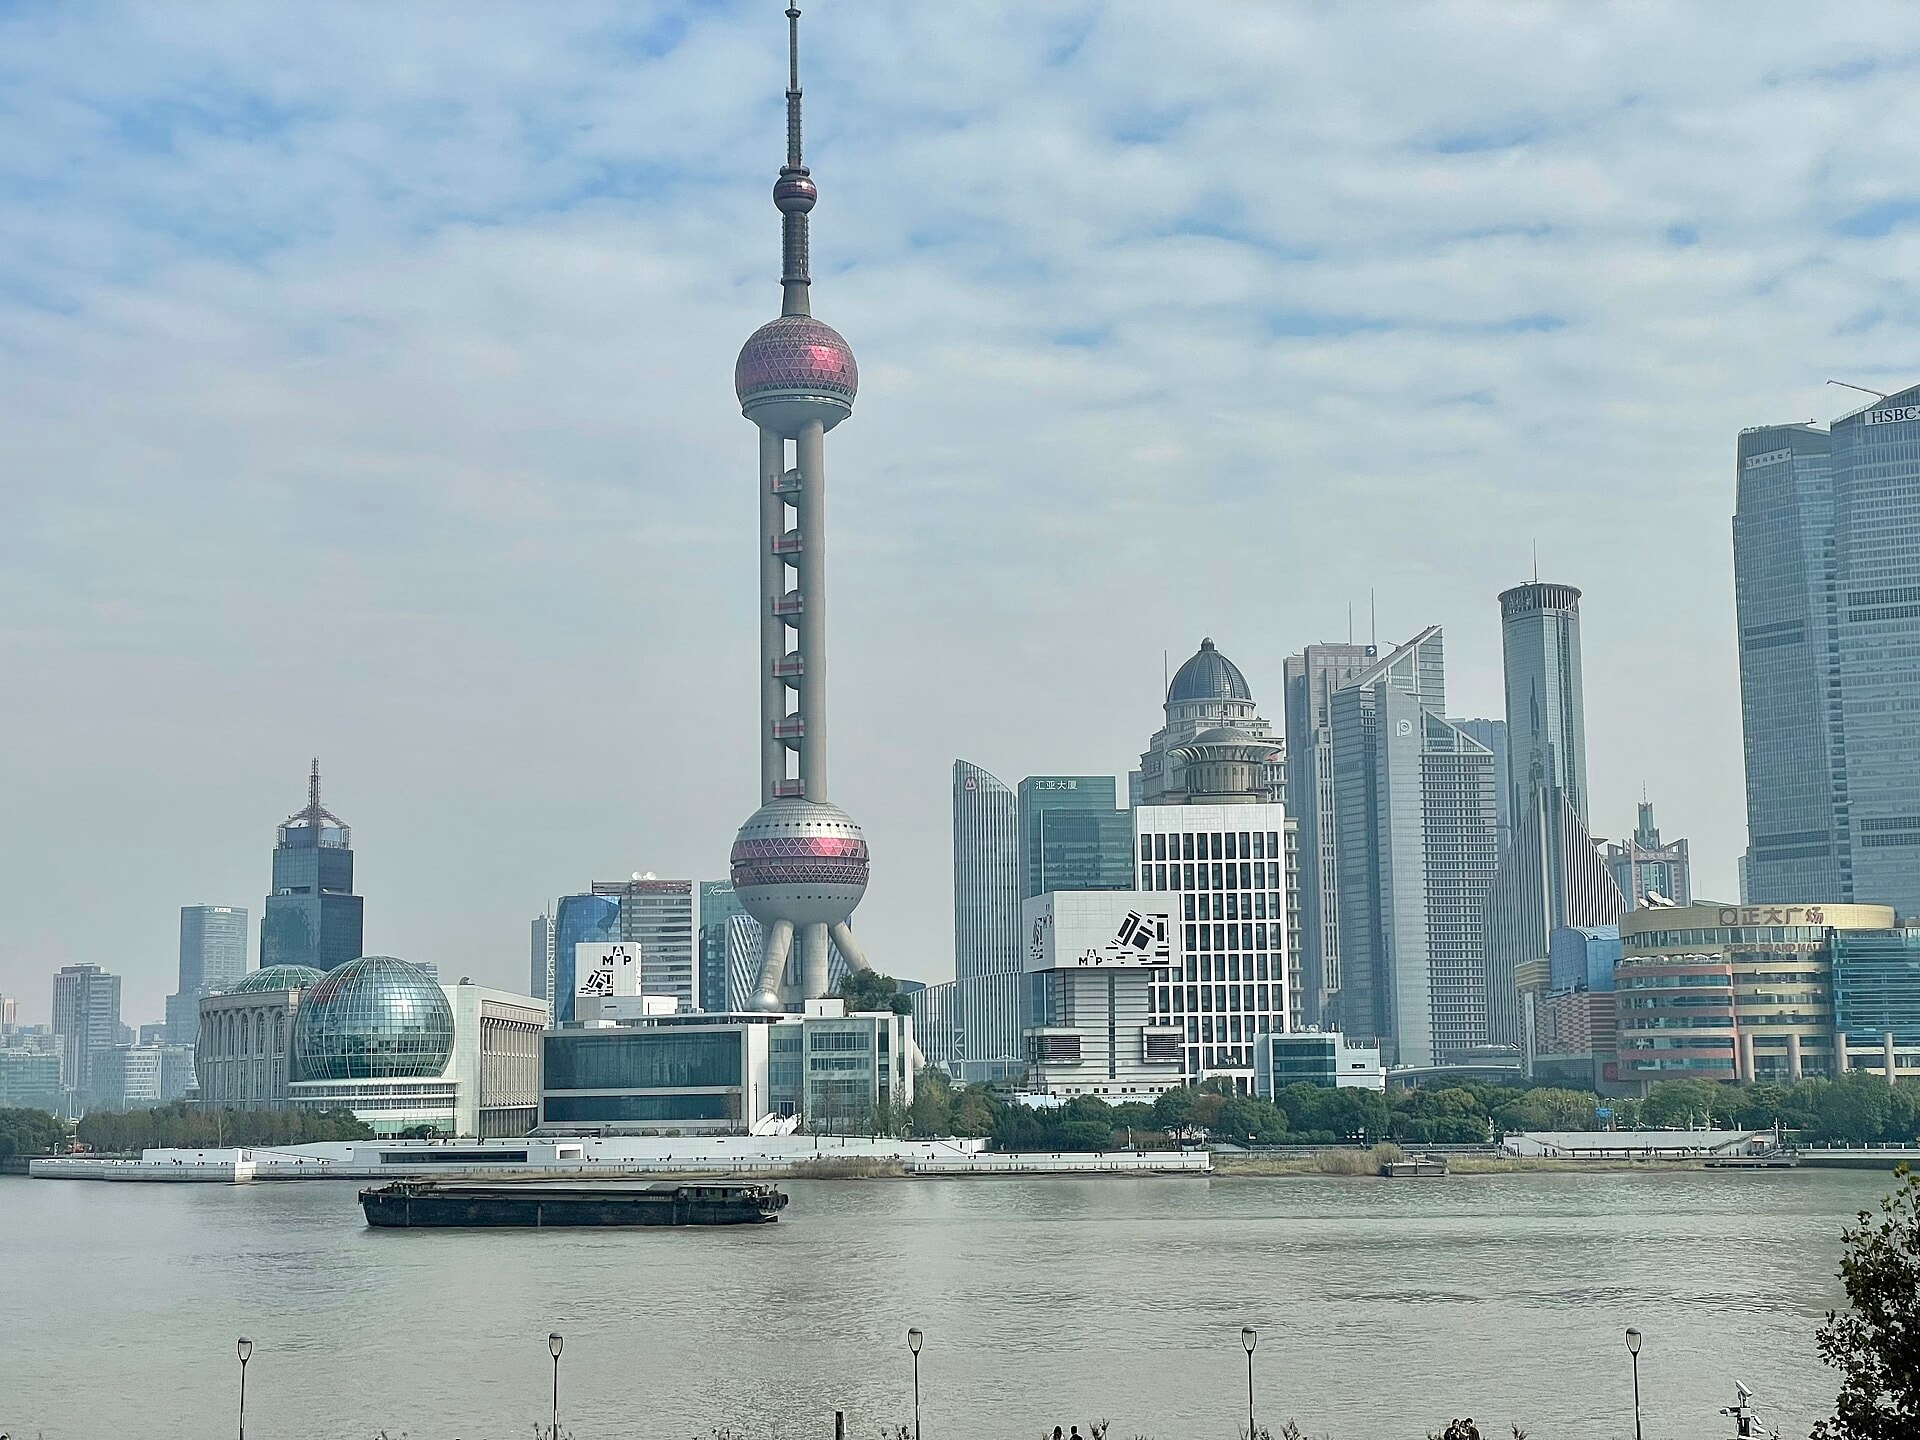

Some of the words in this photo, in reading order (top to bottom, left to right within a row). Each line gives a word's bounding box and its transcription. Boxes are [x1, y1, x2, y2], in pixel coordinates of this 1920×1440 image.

[1871, 407, 1917, 424] HSBC
[1035, 780, 1078, 790] 汇亚大厦
[1740, 906, 1825, 926] 正大广场
[602, 945, 632, 966] MAP
[1078, 948, 1103, 966] MAP
